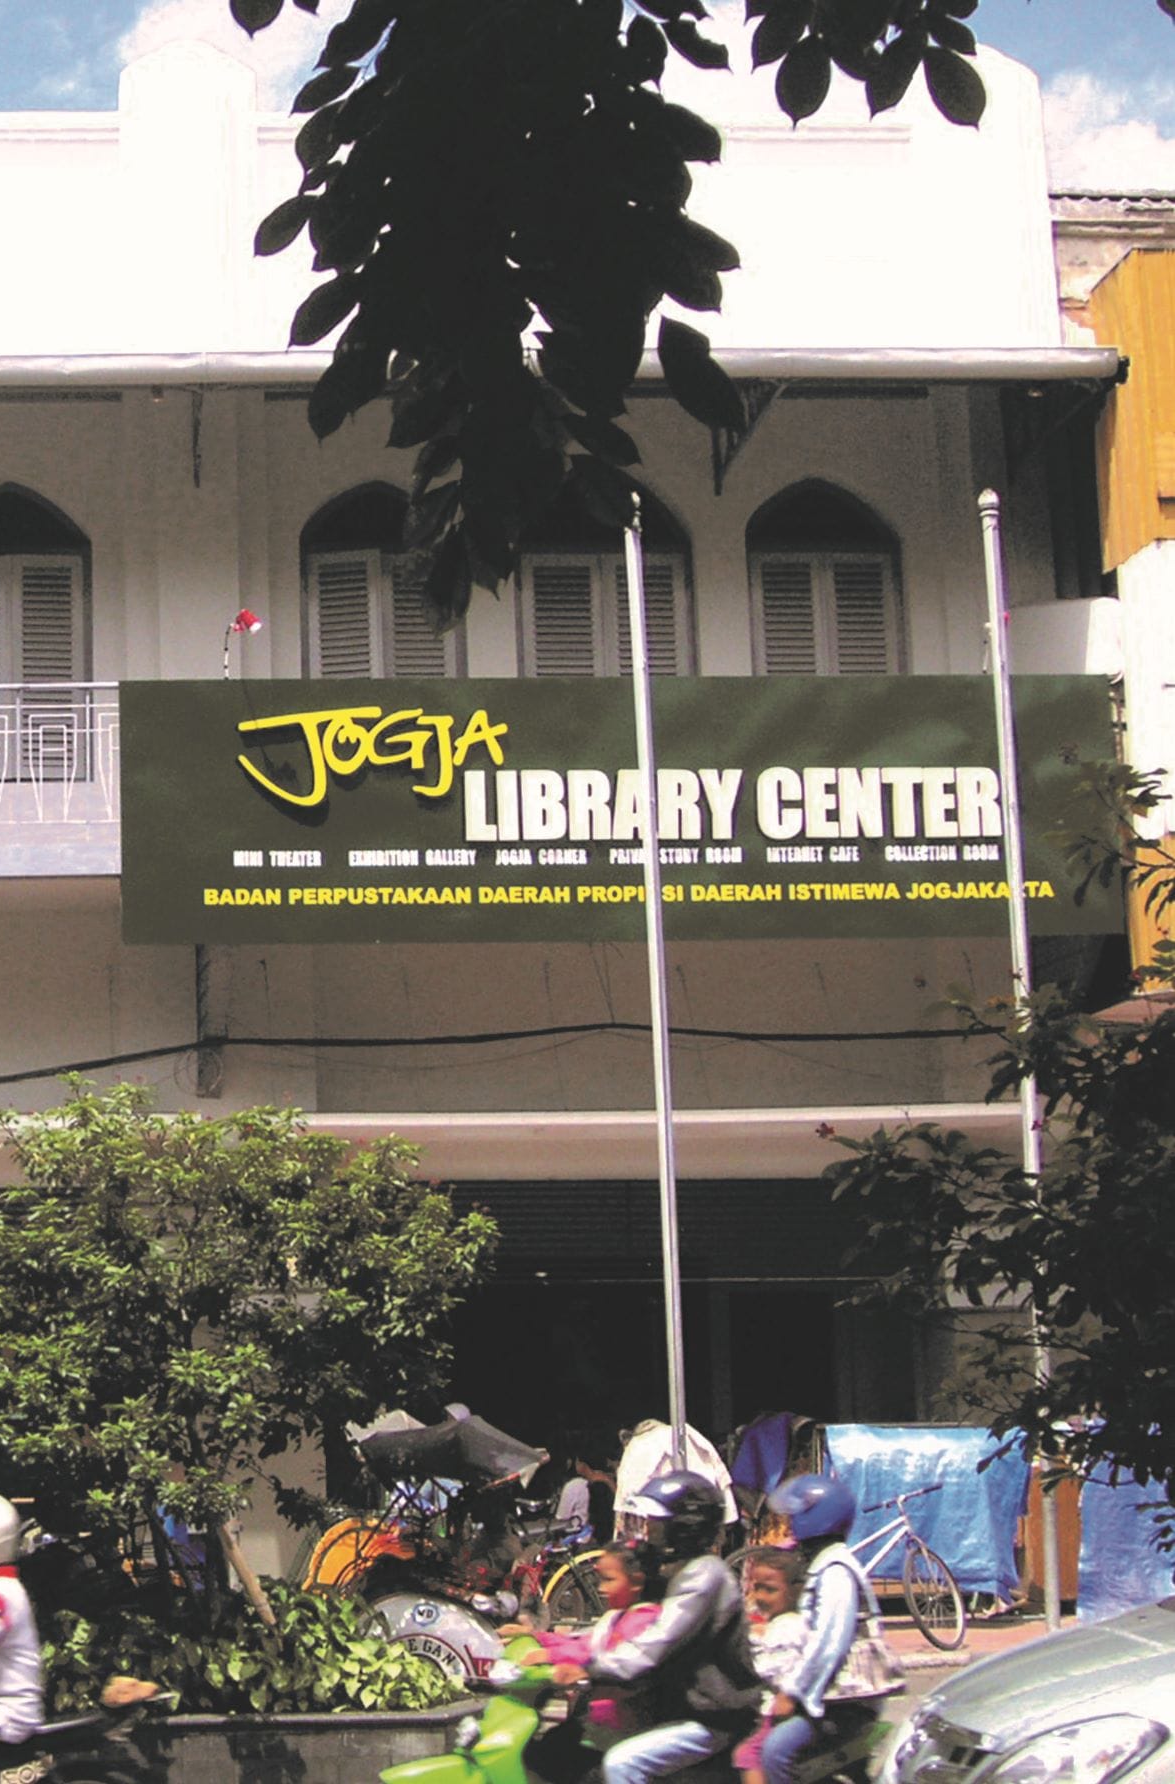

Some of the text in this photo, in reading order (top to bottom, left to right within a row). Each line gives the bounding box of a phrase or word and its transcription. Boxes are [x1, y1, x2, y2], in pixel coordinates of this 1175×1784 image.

[237, 705, 509, 807] JOGJA
[463, 766, 1004, 842] LIBRARY CENTER
[233, 850, 322, 867] MINI THEATER
[348, 848, 477, 867] EXHIBITION GALLERY
[495, 847, 588, 866] JOGJA CORNER
[659, 847, 699, 864] STUDY
[705, 846, 743, 864] ROOM
[766, 845, 860, 863] INTERNET CAFE
[884, 843, 999, 862] COLLECTION ROOM
[203, 880, 1055, 906] BADAN PERPUSTAKAAN DAERAH PROPISI DAERAH ISTIMEWA JOGJAKATA
